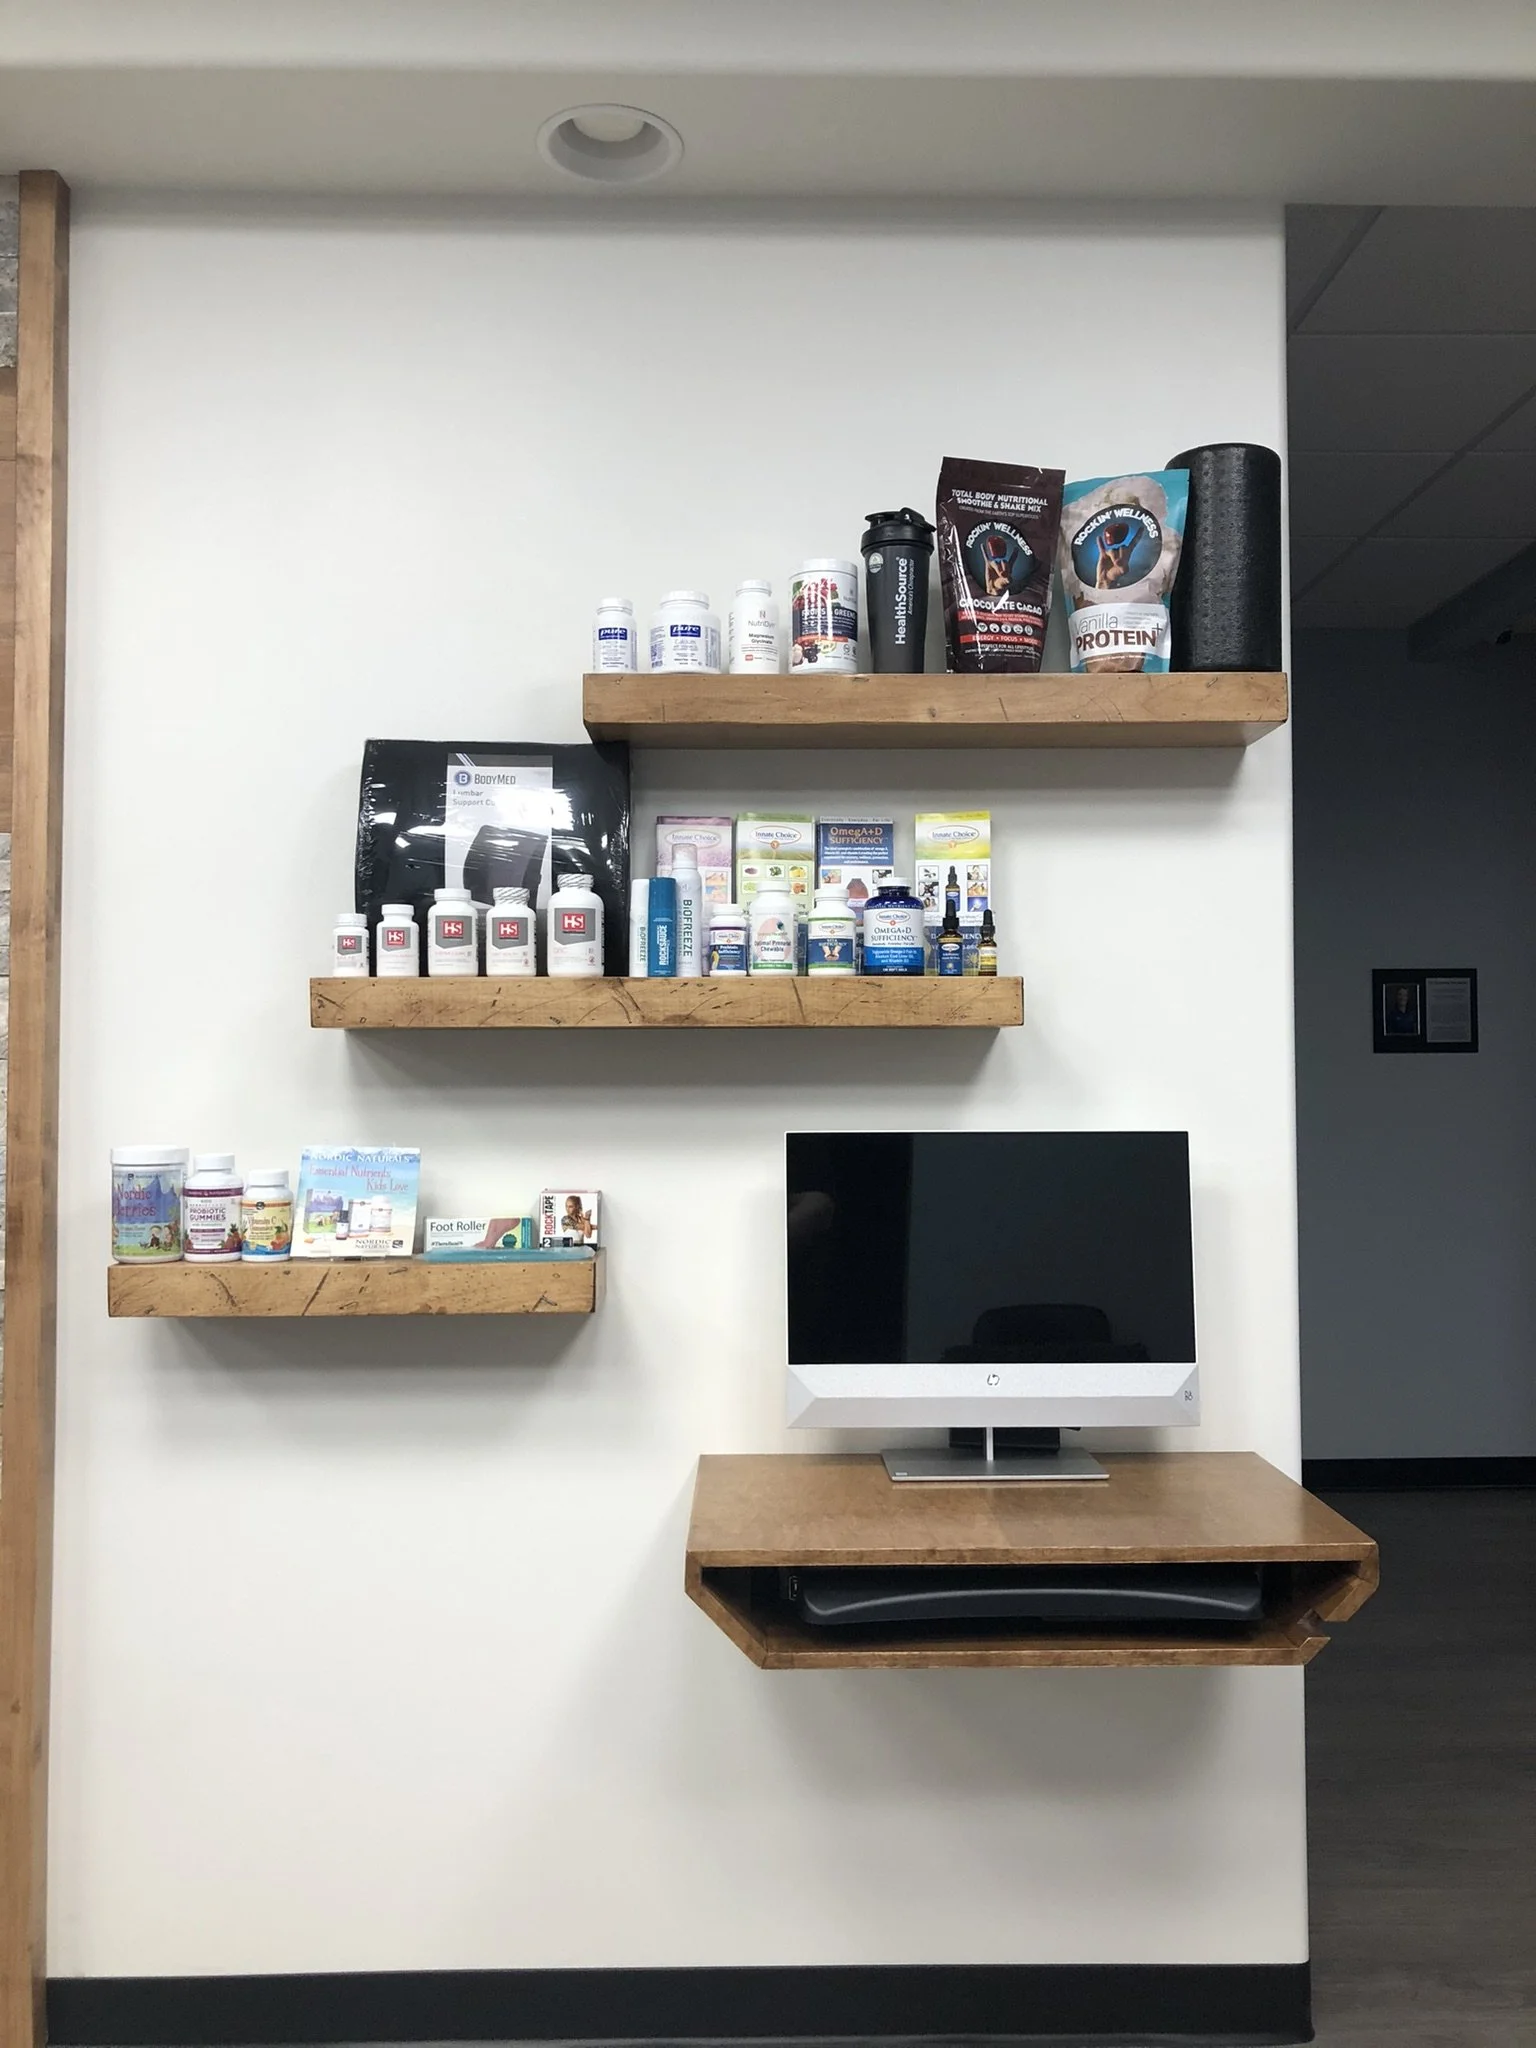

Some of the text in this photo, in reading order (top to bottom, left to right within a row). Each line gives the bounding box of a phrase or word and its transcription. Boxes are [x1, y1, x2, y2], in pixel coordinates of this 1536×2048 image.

[952, 489, 1048, 506] TOTAL BODY NUTRITIONAL
[957, 497, 992, 509] SMOOTHIE
[1000, 502, 1026, 512] SHAKE
[1074, 508, 1159, 546] ROCKIN' WELLNESS
[966, 522, 1033, 556] ROCKIN' WELLNESS
[672, 624, 700, 632] pure
[830, 836, 884, 845] SUFFICIENCY
[444, 922, 462, 934] HS
[564, 915, 584, 928] HS
[501, 924, 518, 935] HS
[388, 932, 404, 941] HS
[310, 1164, 391, 1178] Essential Nutrients
[366, 1178, 409, 1192] Kids Love
[544, 1196, 554, 1235] ROCKTAPE
[430, 1220, 486, 1232] Foot Roller
[544, 1239, 551, 1248] 2
